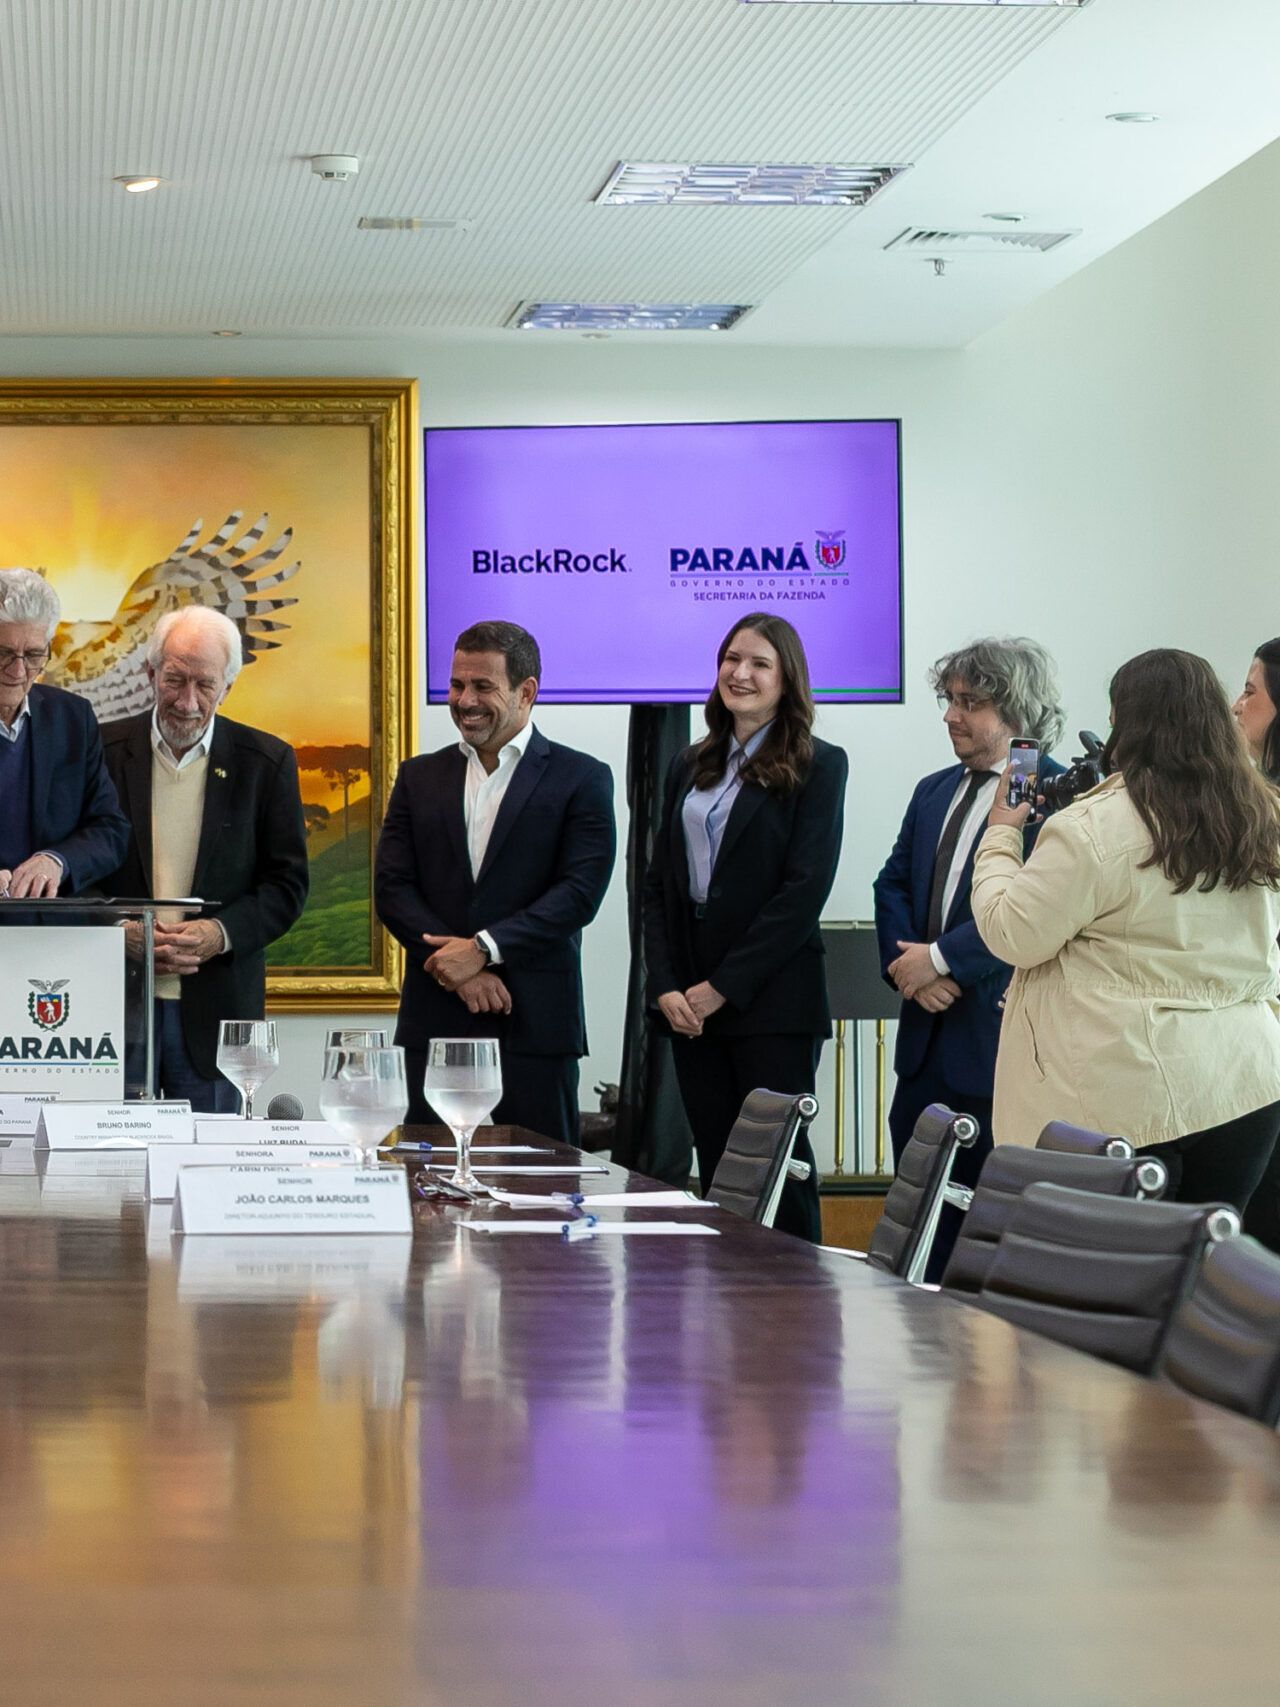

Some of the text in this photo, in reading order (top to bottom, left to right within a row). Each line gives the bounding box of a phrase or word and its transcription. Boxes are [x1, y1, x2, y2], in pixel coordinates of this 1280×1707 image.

[670, 542, 810, 572] PARANÁ
[670, 578, 850, 587] GOVERNO DO ESTADO
[694, 591, 825, 601] SECRETARIA DA FAZENDA
[267, 1195, 313, 1204] CARLOS
[316, 1195, 370, 1204] MARQUES
